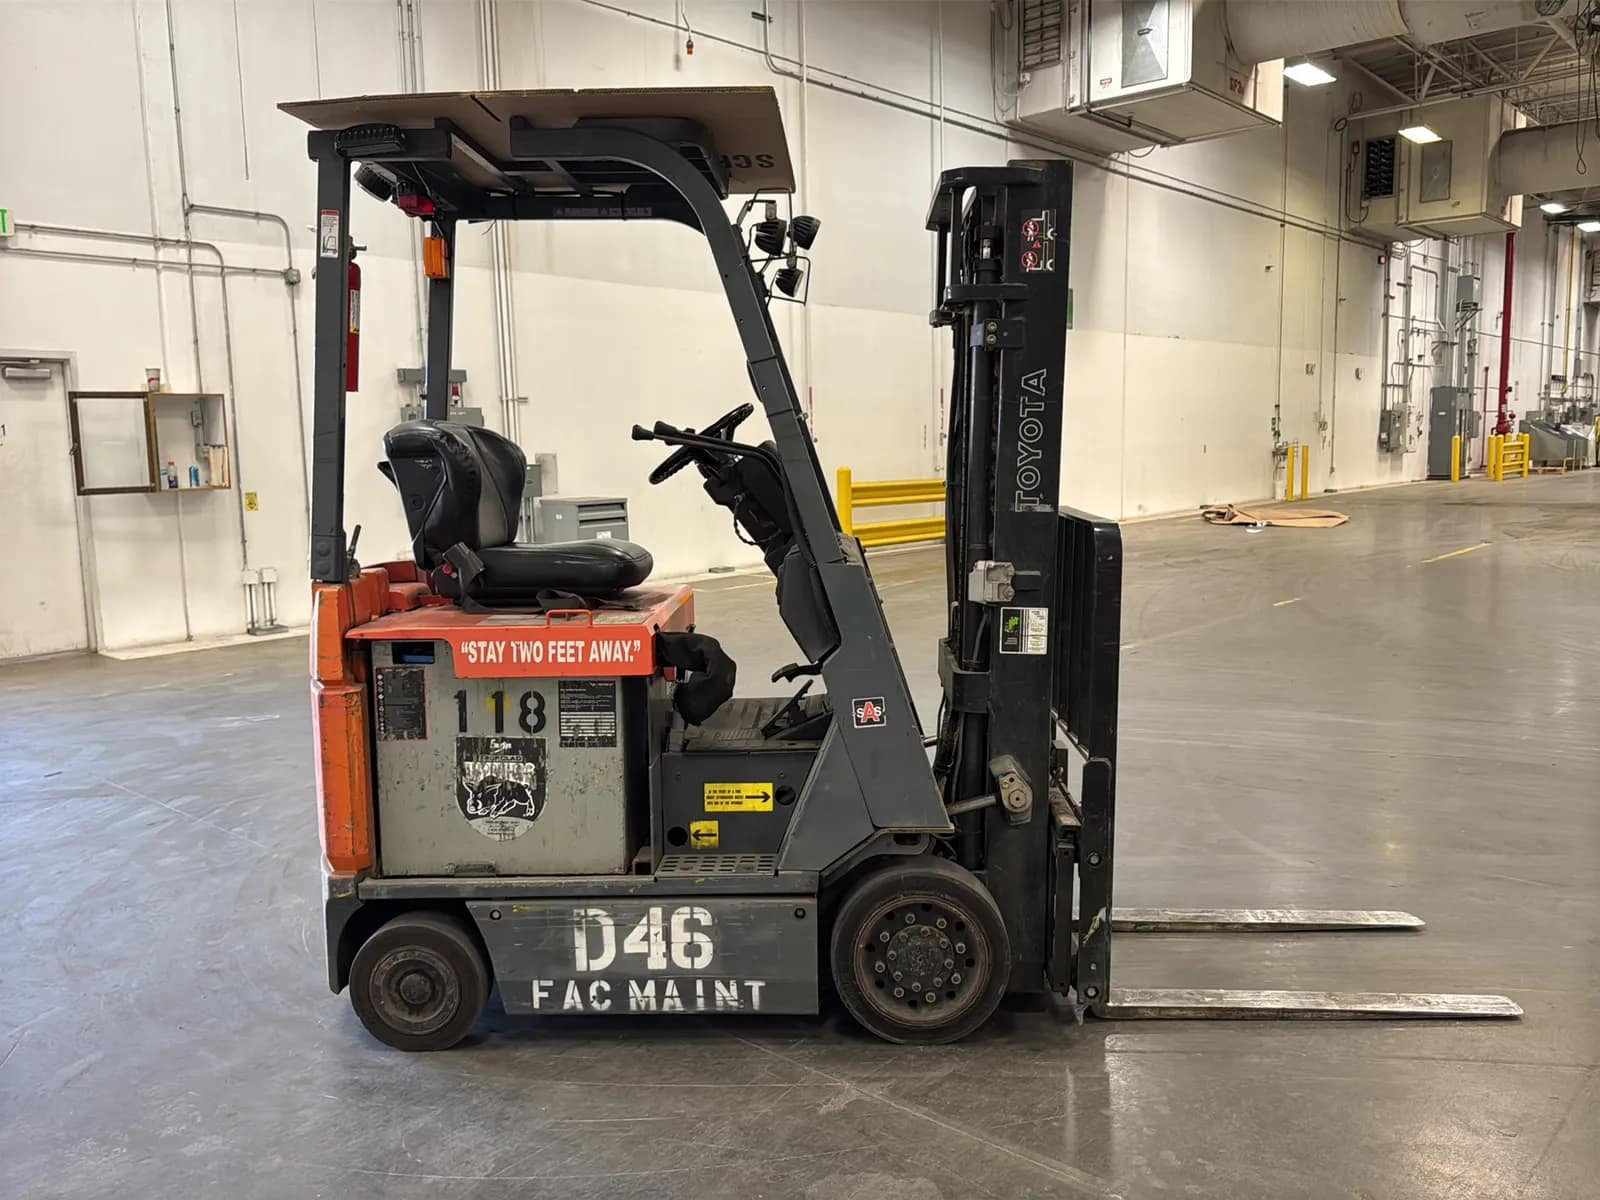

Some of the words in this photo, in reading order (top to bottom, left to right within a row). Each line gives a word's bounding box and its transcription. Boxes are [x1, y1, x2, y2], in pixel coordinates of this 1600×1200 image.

[1015, 368, 1047, 513] TOYOTA
[510, 640, 544, 663] TWO
[548, 640, 585, 663] FEET
[856, 701, 882, 723] SAS
[573, 906, 714, 971] D46
[532, 979, 612, 1011] FAC
[628, 979, 767, 1012] MAINT
